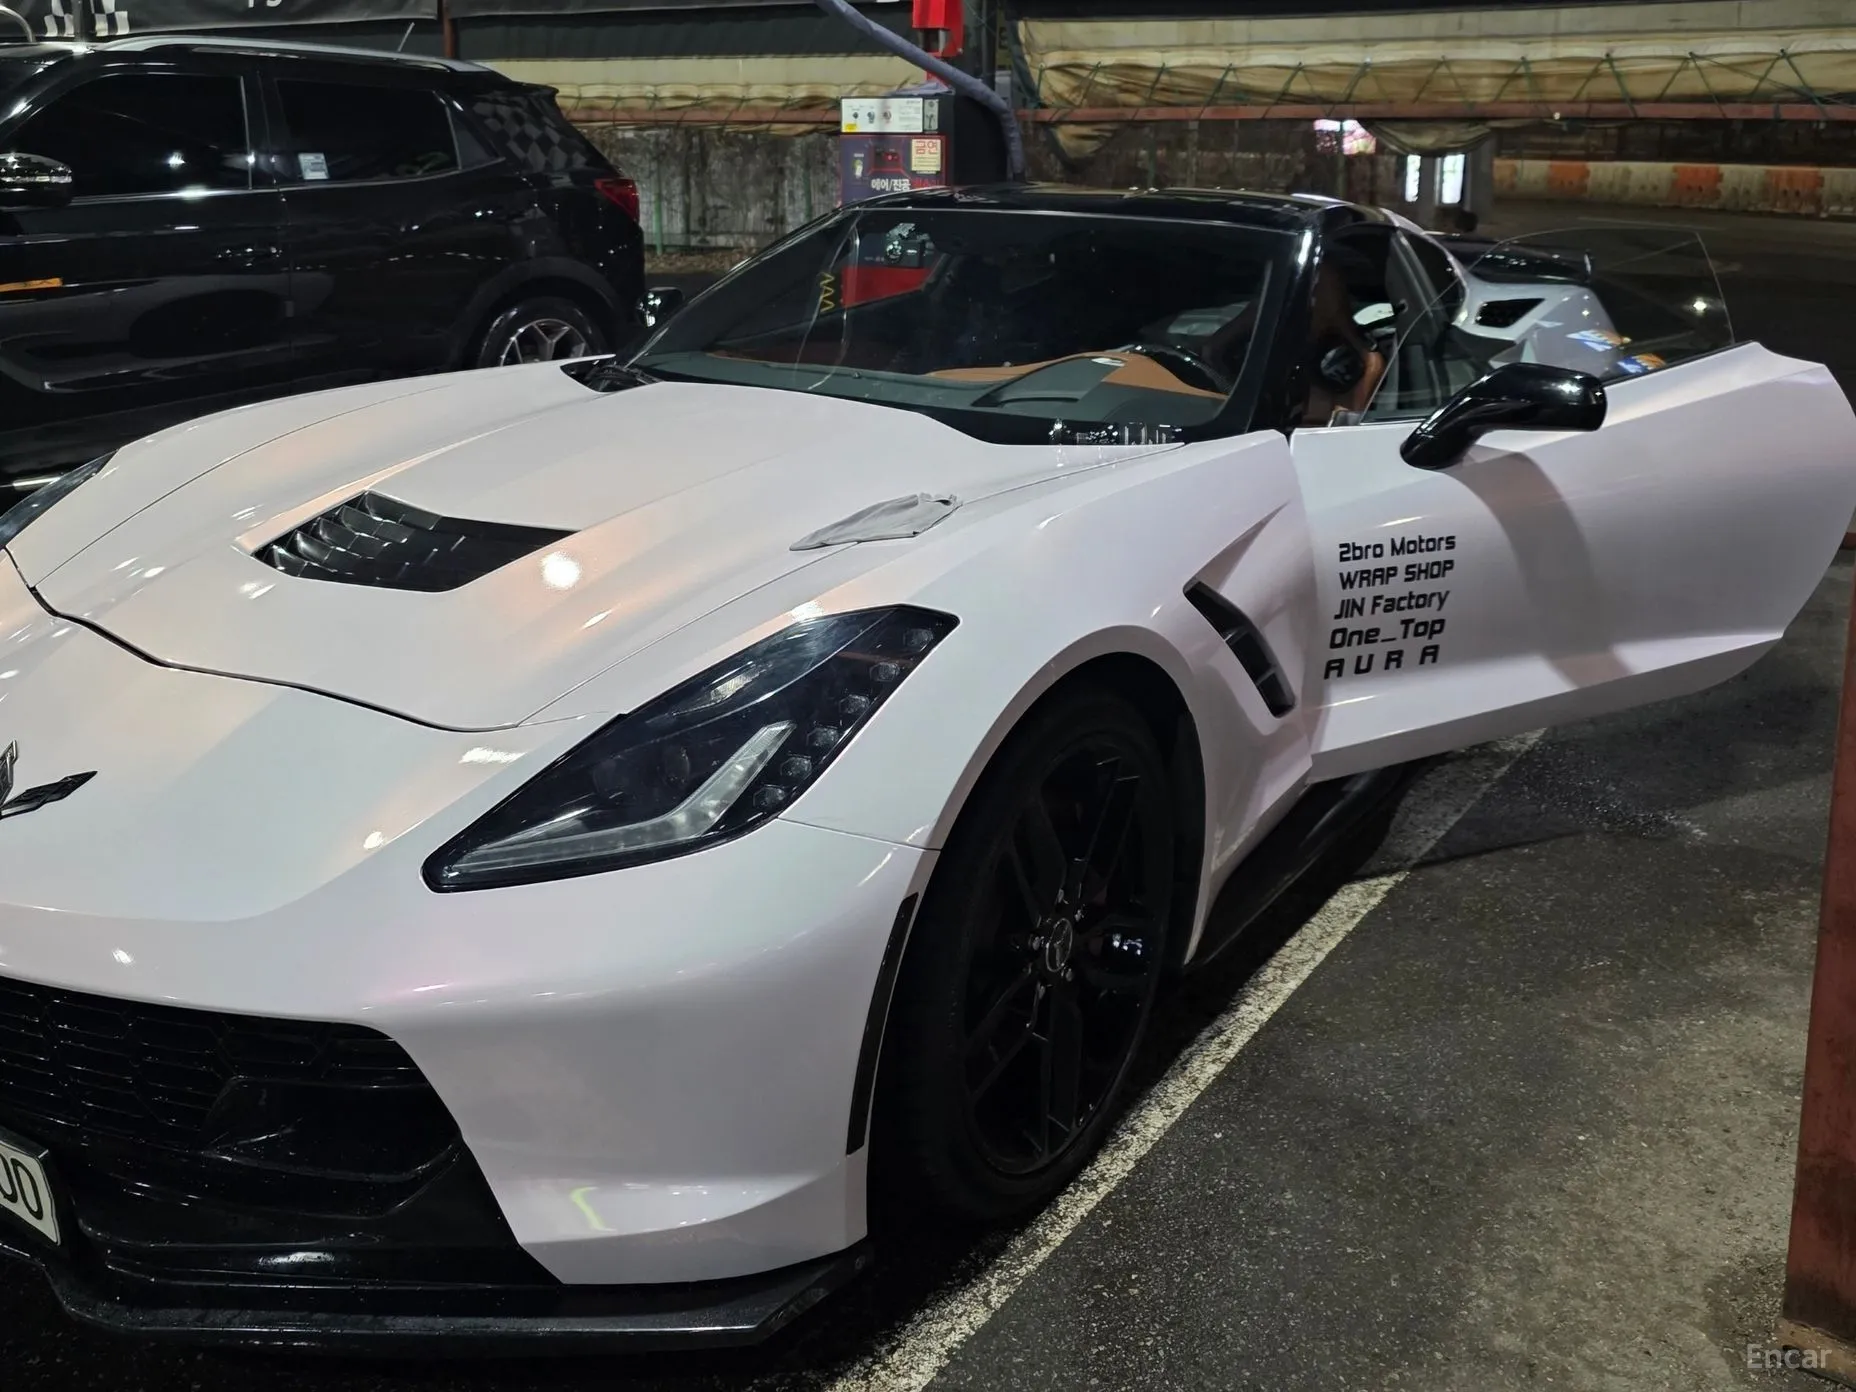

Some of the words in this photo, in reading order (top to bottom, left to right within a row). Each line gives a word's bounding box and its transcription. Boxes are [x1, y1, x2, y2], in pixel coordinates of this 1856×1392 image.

[1339, 542, 1384, 562] 2bro
[1391, 535, 1456, 556] Motors
[1339, 566, 1398, 590] WRAP
[1404, 559, 1455, 583] SHOP
[1333, 597, 1365, 620] JIN
[1370, 590, 1451, 615] Factory
[1329, 618, 1446, 649] One_Top
